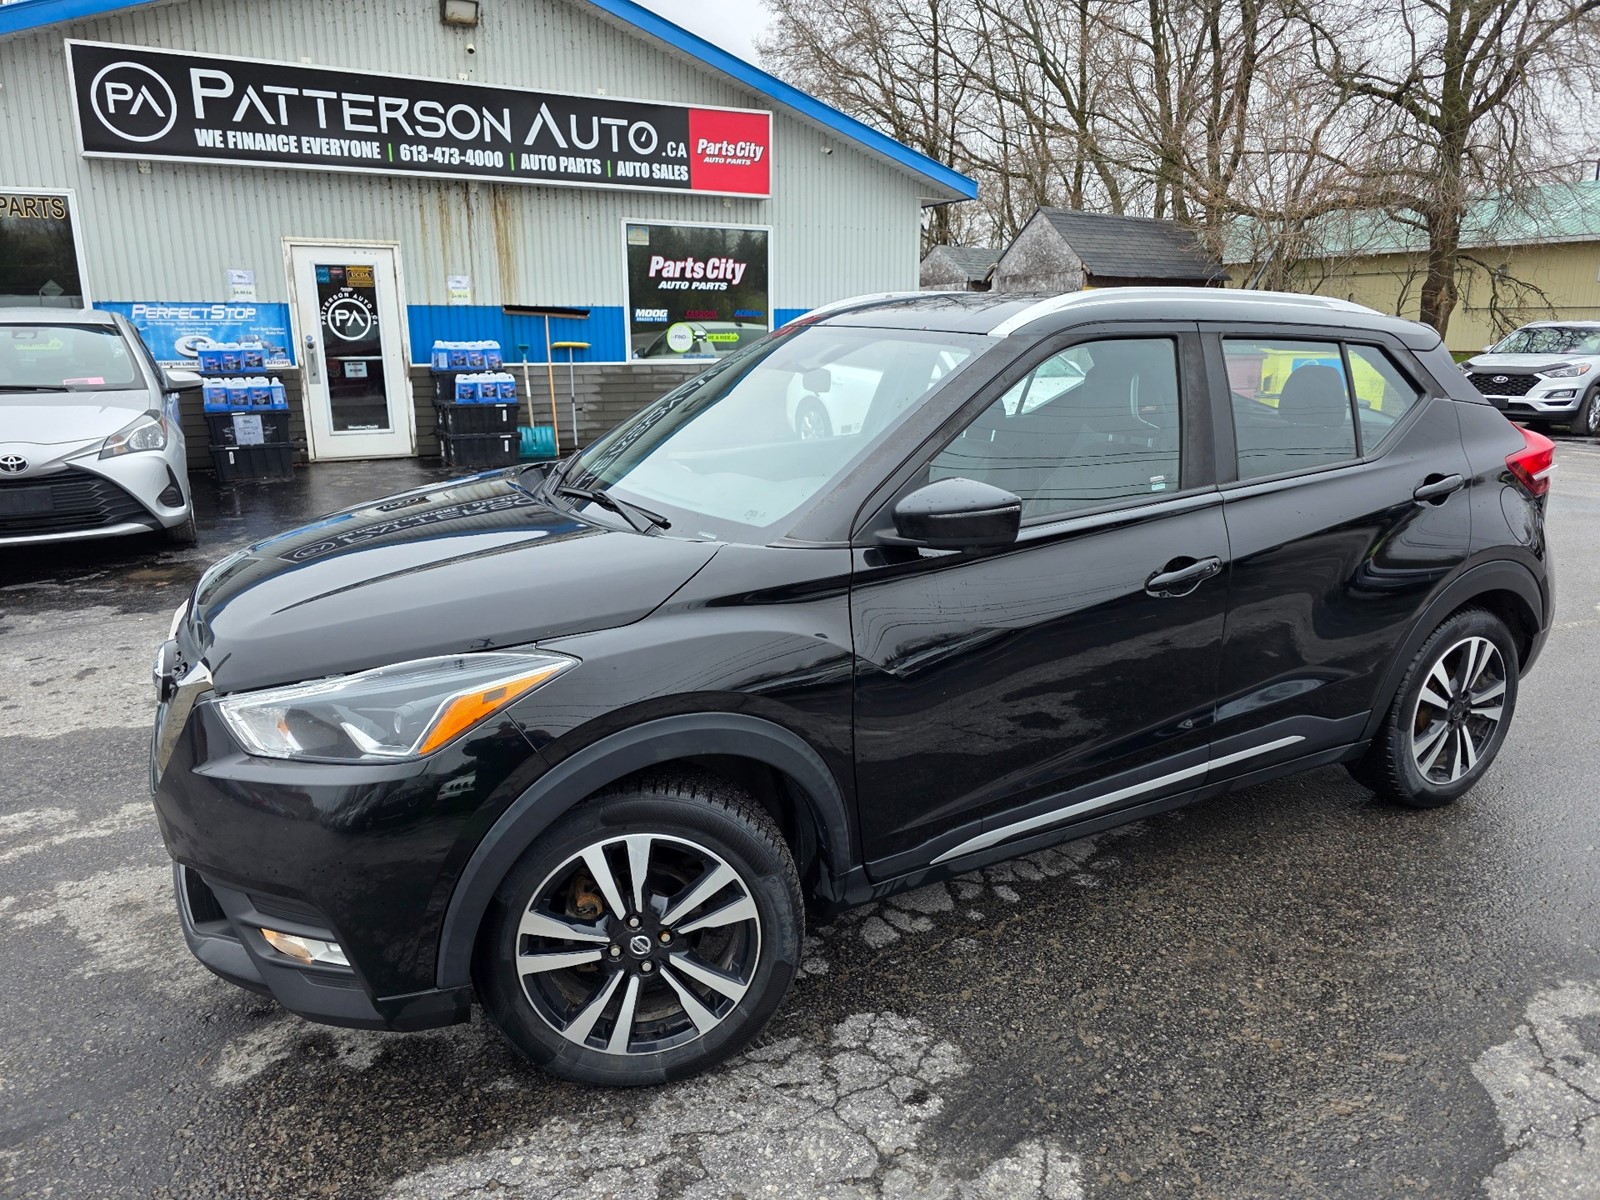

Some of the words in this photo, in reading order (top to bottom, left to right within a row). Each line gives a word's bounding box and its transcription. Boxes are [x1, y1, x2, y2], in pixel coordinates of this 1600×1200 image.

[104, 81, 166, 118] PA
[189, 67, 512, 144] PATTERSON
[524, 102, 659, 156] AUTO
[661, 141, 688, 159] .CA
[194, 128, 224, 148] WE
[227, 130, 299, 153] FINANCE
[301, 136, 382, 160] EVERYONE
[399, 143, 504, 169] 613-473-4000
[697, 138, 764, 162] PartsCity
[520, 154, 557, 172] AUTO
[559, 156, 602, 175] PARTS
[616, 160, 651, 178] AUTO
[652, 162, 689, 181] SALES
[703, 156, 725, 164] AUTO
[726, 157, 752, 166] PARTS
[649, 255, 747, 285] PartsCity
[658, 280, 690, 290] AUTO
[691, 281, 728, 291] PARTS
[320, 292, 349, 326] PATTERSON
[352, 293, 373, 309] AUTO
[334, 309, 366, 327] PA
[635, 308, 668, 317] MOOG
